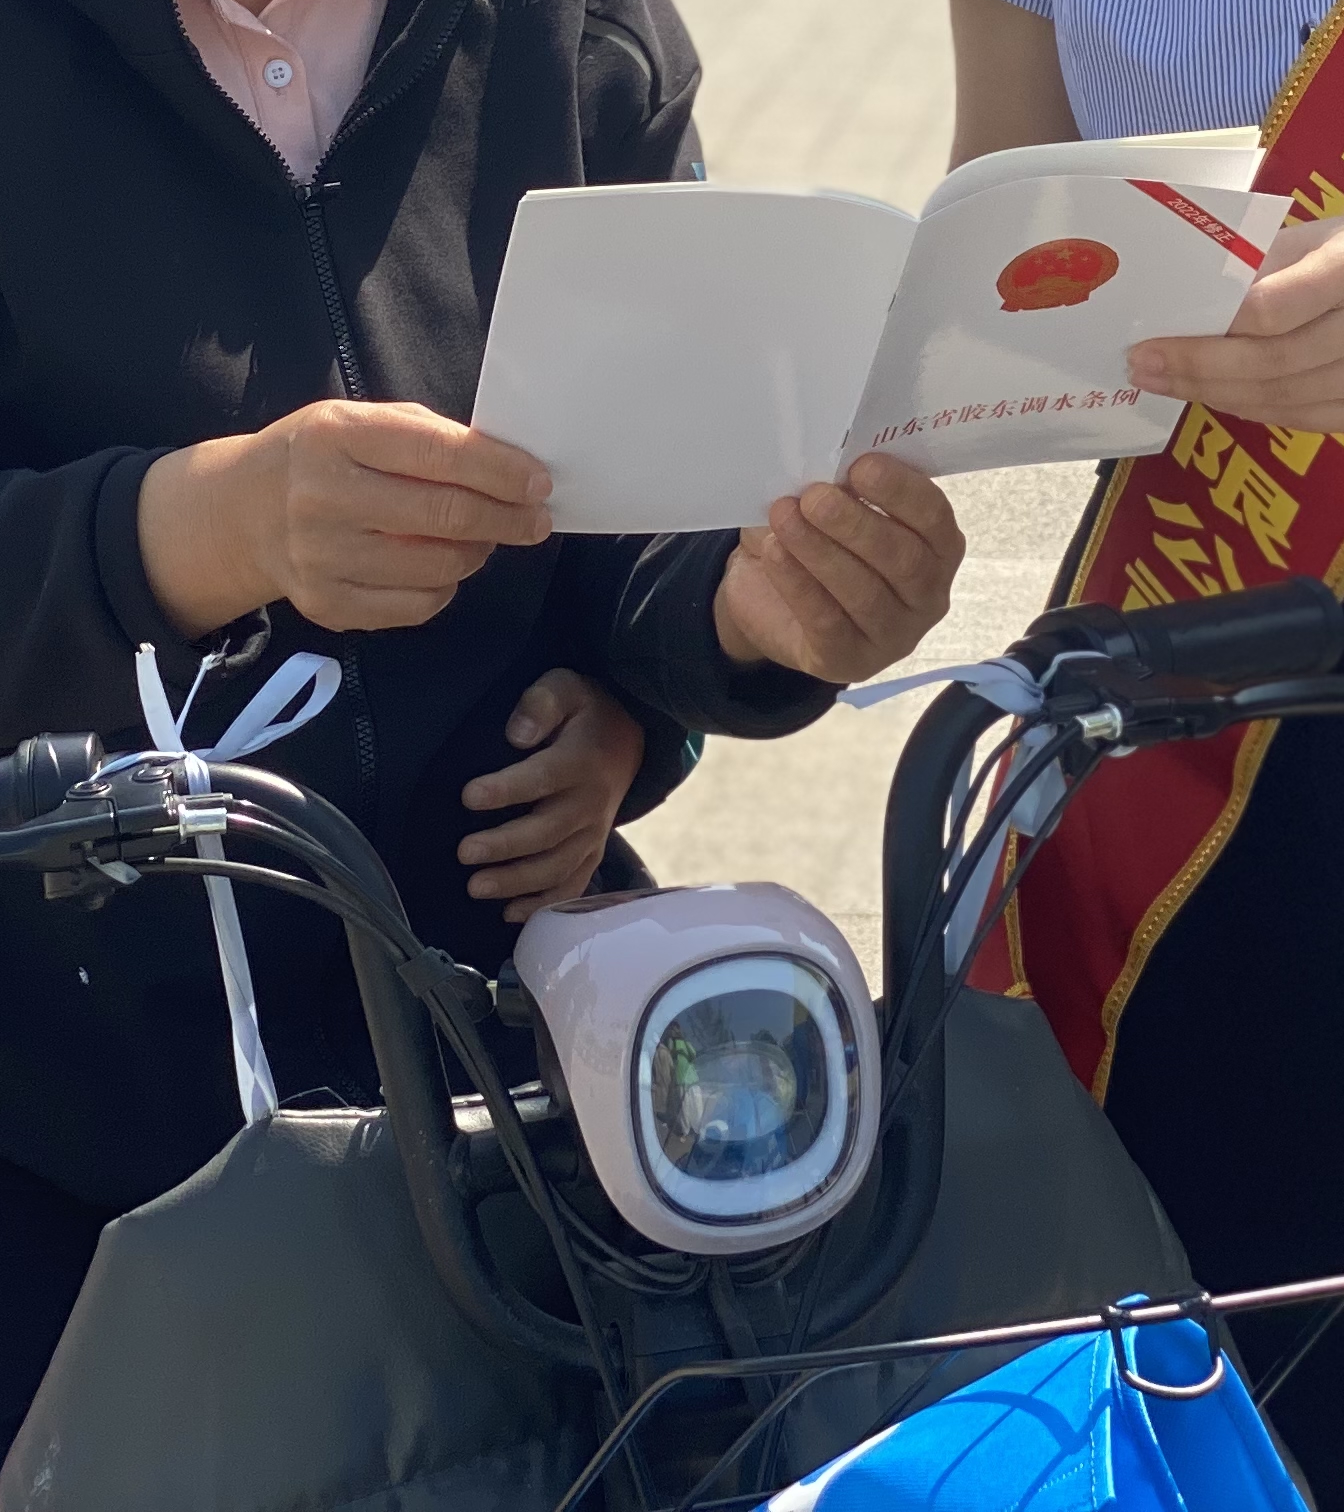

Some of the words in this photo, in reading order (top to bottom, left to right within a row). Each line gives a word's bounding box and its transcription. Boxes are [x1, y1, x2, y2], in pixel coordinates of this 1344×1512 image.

[1166, 197, 1236, 244] 2022年修正
[871, 387, 1142, 448] 山东省胶东调水条例
